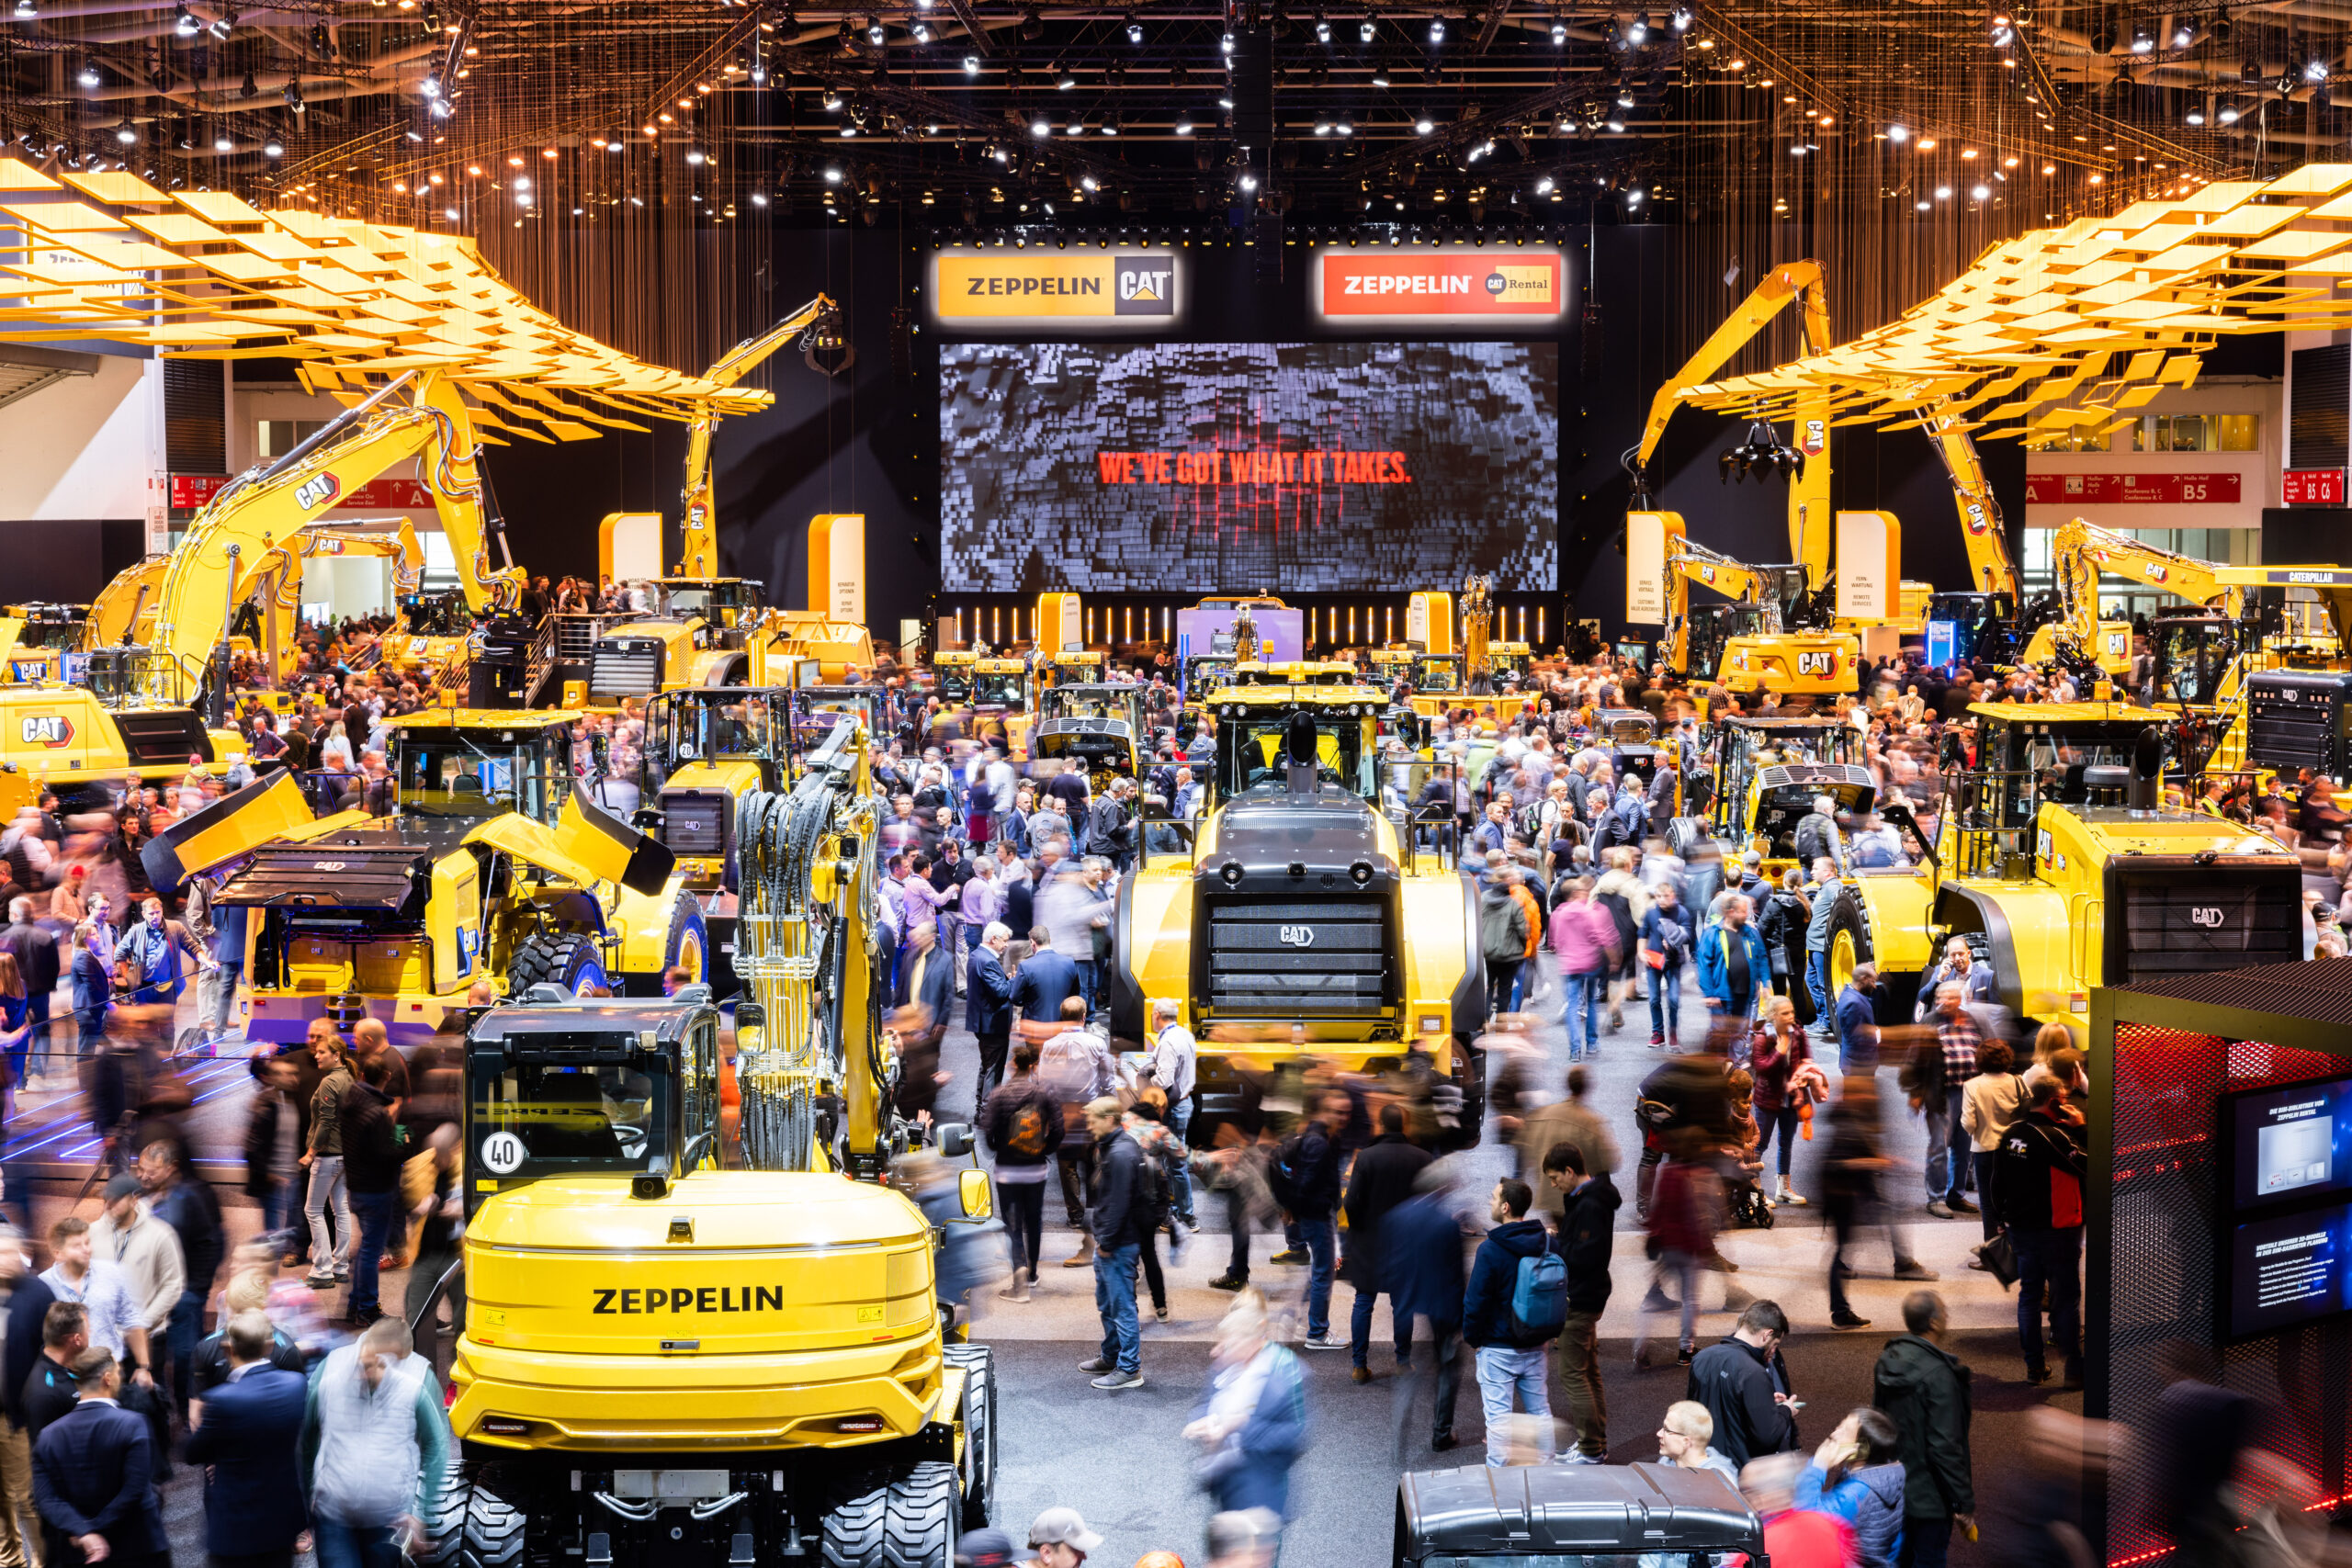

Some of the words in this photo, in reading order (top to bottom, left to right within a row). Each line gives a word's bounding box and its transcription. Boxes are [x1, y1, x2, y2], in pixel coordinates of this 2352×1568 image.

[967, 277, 1101, 295] ZEPPELIN
[1120, 271, 1168, 300] CAT
[1344, 276, 1469, 294] ZEPPELIN
[1487, 278, 1504, 289] CAT
[1509, 279, 1548, 289] Rental
[1806, 420, 1824, 449] CAT
[1098, 451, 1172, 483] WE'VE
[1177, 451, 1222, 484] GOT
[1230, 451, 1297, 483] WHAT
[1303, 451, 1324, 483] IT
[1330, 451, 1412, 484] TAKES.
[295, 472, 331, 511] CAT
[410, 491, 425, 505] A
[2026, 486, 2039, 501] A
[2183, 484, 2207, 500] B5
[2307, 483, 2316, 500] B5
[2321, 482, 2331, 500] C6
[691, 507, 705, 530] CAT
[1967, 503, 1986, 528] CAT
[320, 539, 340, 552] CAT
[1702, 565, 1714, 581] CAT
[2146, 562, 2165, 581] CAT
[2290, 571, 2334, 583] CATERPILLAR
[409, 638, 429, 651] CAT
[618, 641, 629, 650] CAT
[2109, 634, 2125, 655] CAT
[20, 663, 43, 680] CAT
[1798, 652, 1830, 675] CAT
[2283, 690, 2298, 701] CAT
[22, 716, 62, 742] CAT
[682, 746, 691, 756] 20
[1634, 757, 1645, 765] CAT
[684, 821, 698, 829] CAT
[2038, 829, 2052, 861] CAT
[2192, 908, 2218, 924] CAT
[464, 930, 476, 953] CAT
[1281, 926, 1307, 942] CAT
[2277, 1112, 2300, 1121] ZEPPELIN
[492, 1140, 514, 1165] 40
[593, 1285, 784, 1314] ZEPPELIN
